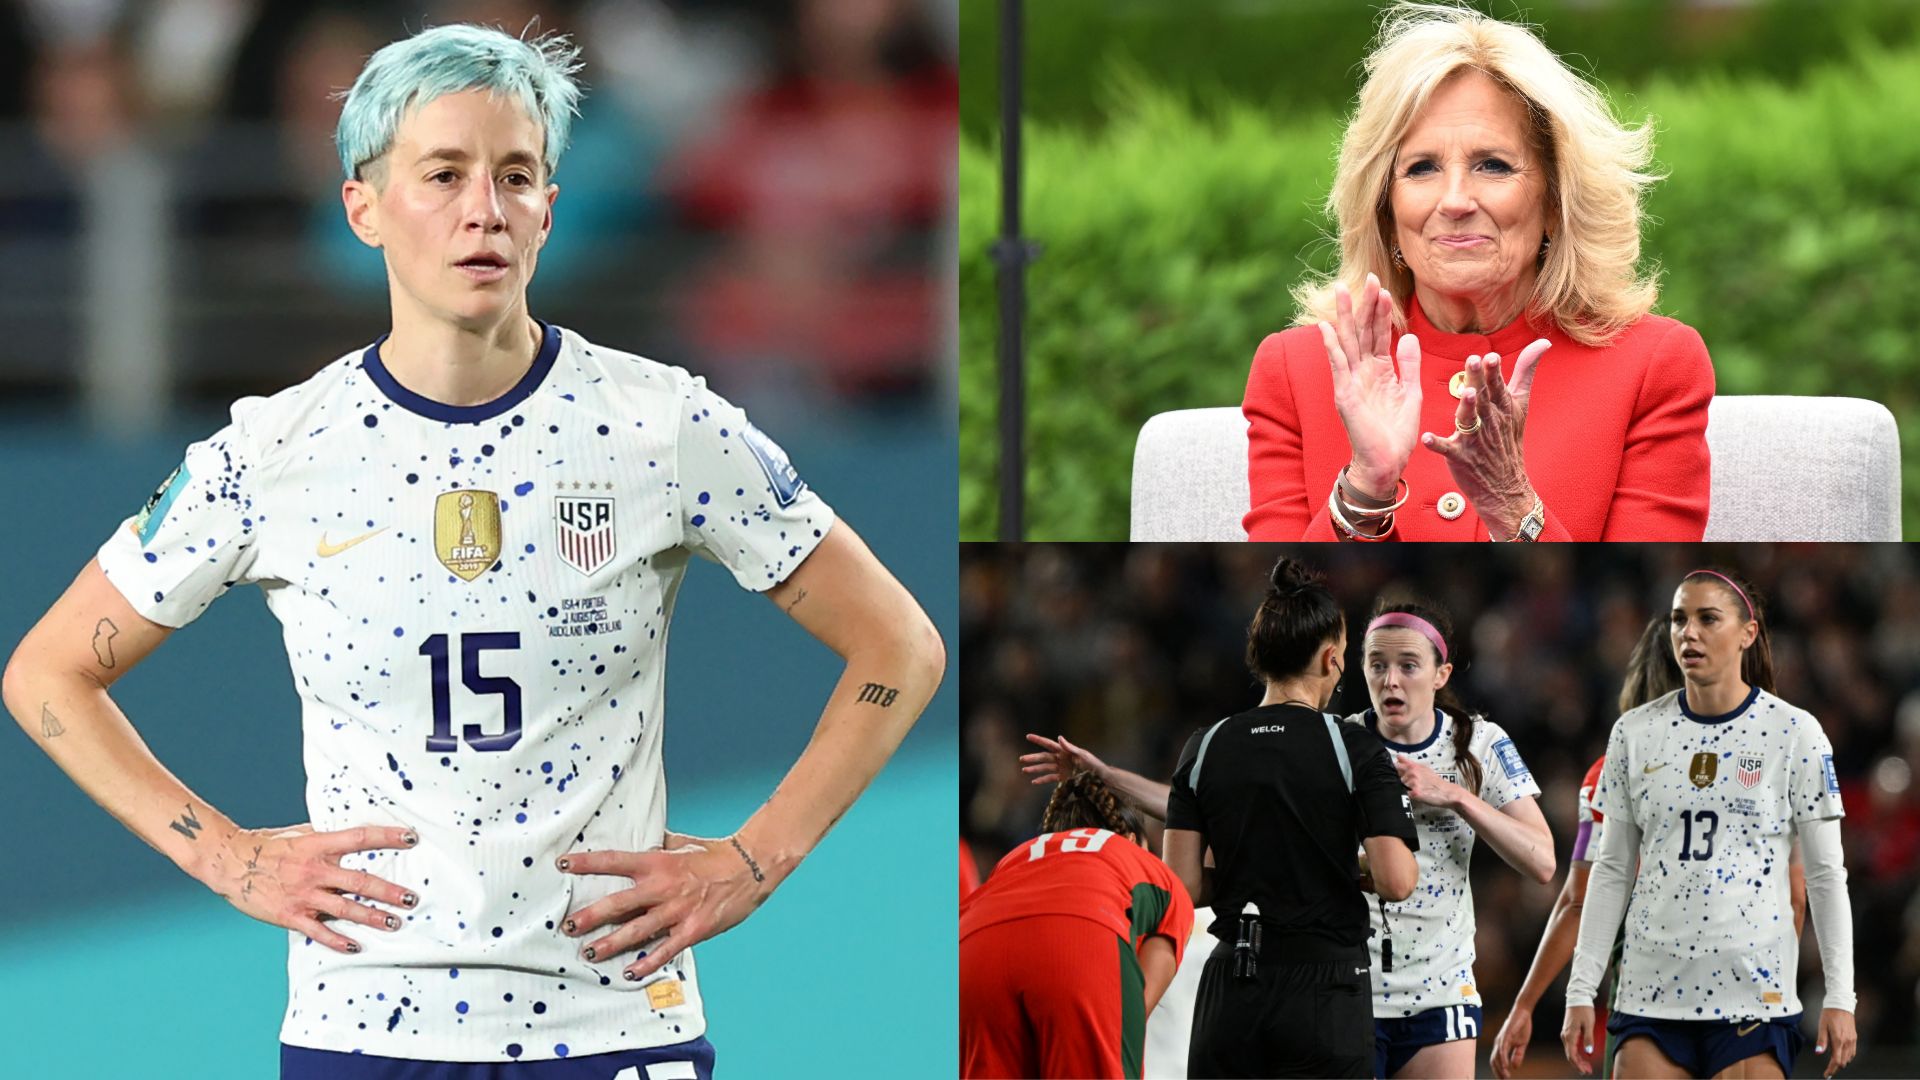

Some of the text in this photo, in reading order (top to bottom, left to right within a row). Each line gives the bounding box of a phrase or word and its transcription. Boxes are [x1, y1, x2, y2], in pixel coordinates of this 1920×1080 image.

[560, 502, 610, 531] USA
[452, 547, 484, 560] FIFA
[562, 599, 574, 609] USA
[419, 632, 522, 752] 15
[1251, 725, 1285, 734] WELCH
[1740, 758, 1762, 771] USA
[169, 803, 203, 840] W
[1679, 810, 1719, 861] 13
[1028, 828, 1116, 862] 19
